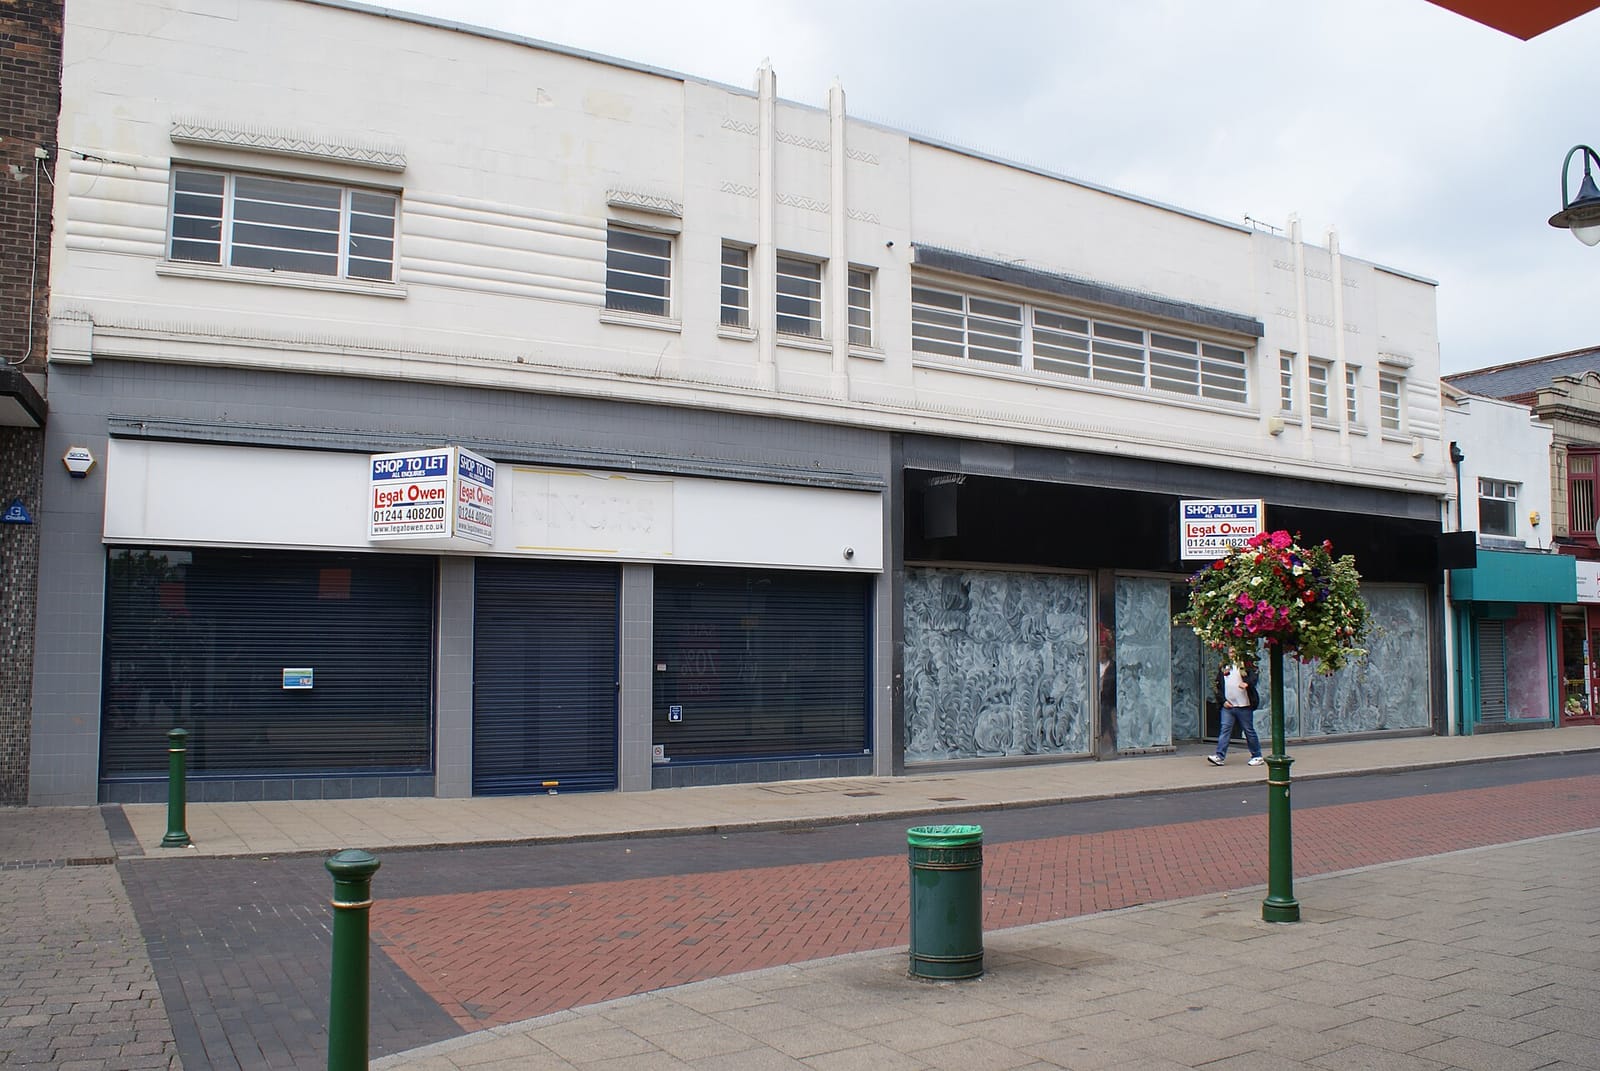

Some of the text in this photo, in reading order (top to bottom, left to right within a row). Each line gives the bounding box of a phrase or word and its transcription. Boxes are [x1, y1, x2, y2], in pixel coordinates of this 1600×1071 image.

[375, 456, 445, 473] SHOP TO LET
[460, 455, 475, 473] SHOP
[476, 462, 484, 476] TO
[485, 467, 493, 480] LET
[374, 484, 445, 509] Legat Owen
[459, 480, 493, 506] Legat Owen
[373, 506, 444, 522] 01244 408200
[1187, 505, 1215, 514] SHOP
[1218, 506, 1233, 514] TO
[374, 523, 444, 533] www.legatowen.co.uk
[1187, 523, 1255, 538] Legat Owen
